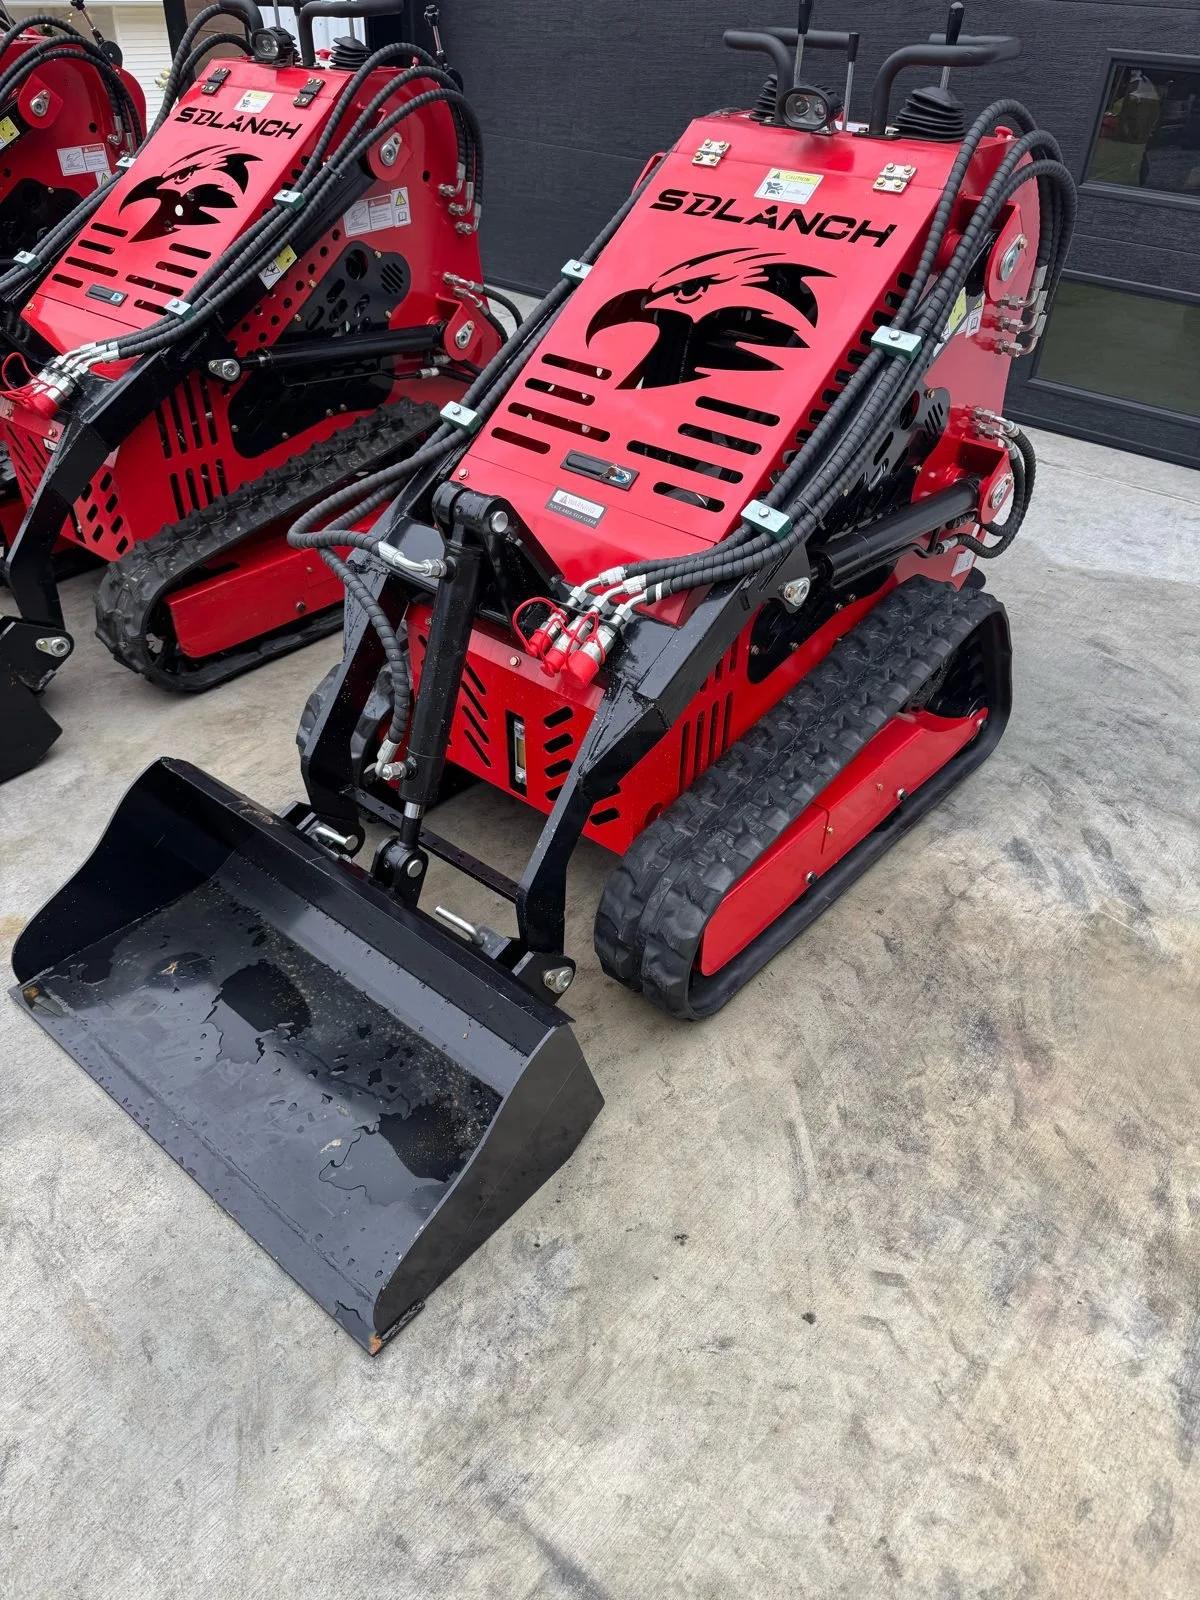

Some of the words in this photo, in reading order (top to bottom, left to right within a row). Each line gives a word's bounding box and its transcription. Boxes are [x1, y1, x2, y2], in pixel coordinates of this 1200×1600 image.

[174, 106, 303, 140] SDLANCH
[785, 174, 811, 182] CAUTION
[649, 188, 898, 248] SDLANCH
[568, 498, 596, 514] WARNING
[562, 507, 573, 515] AREA
[583, 517, 597, 525] CLEAR
